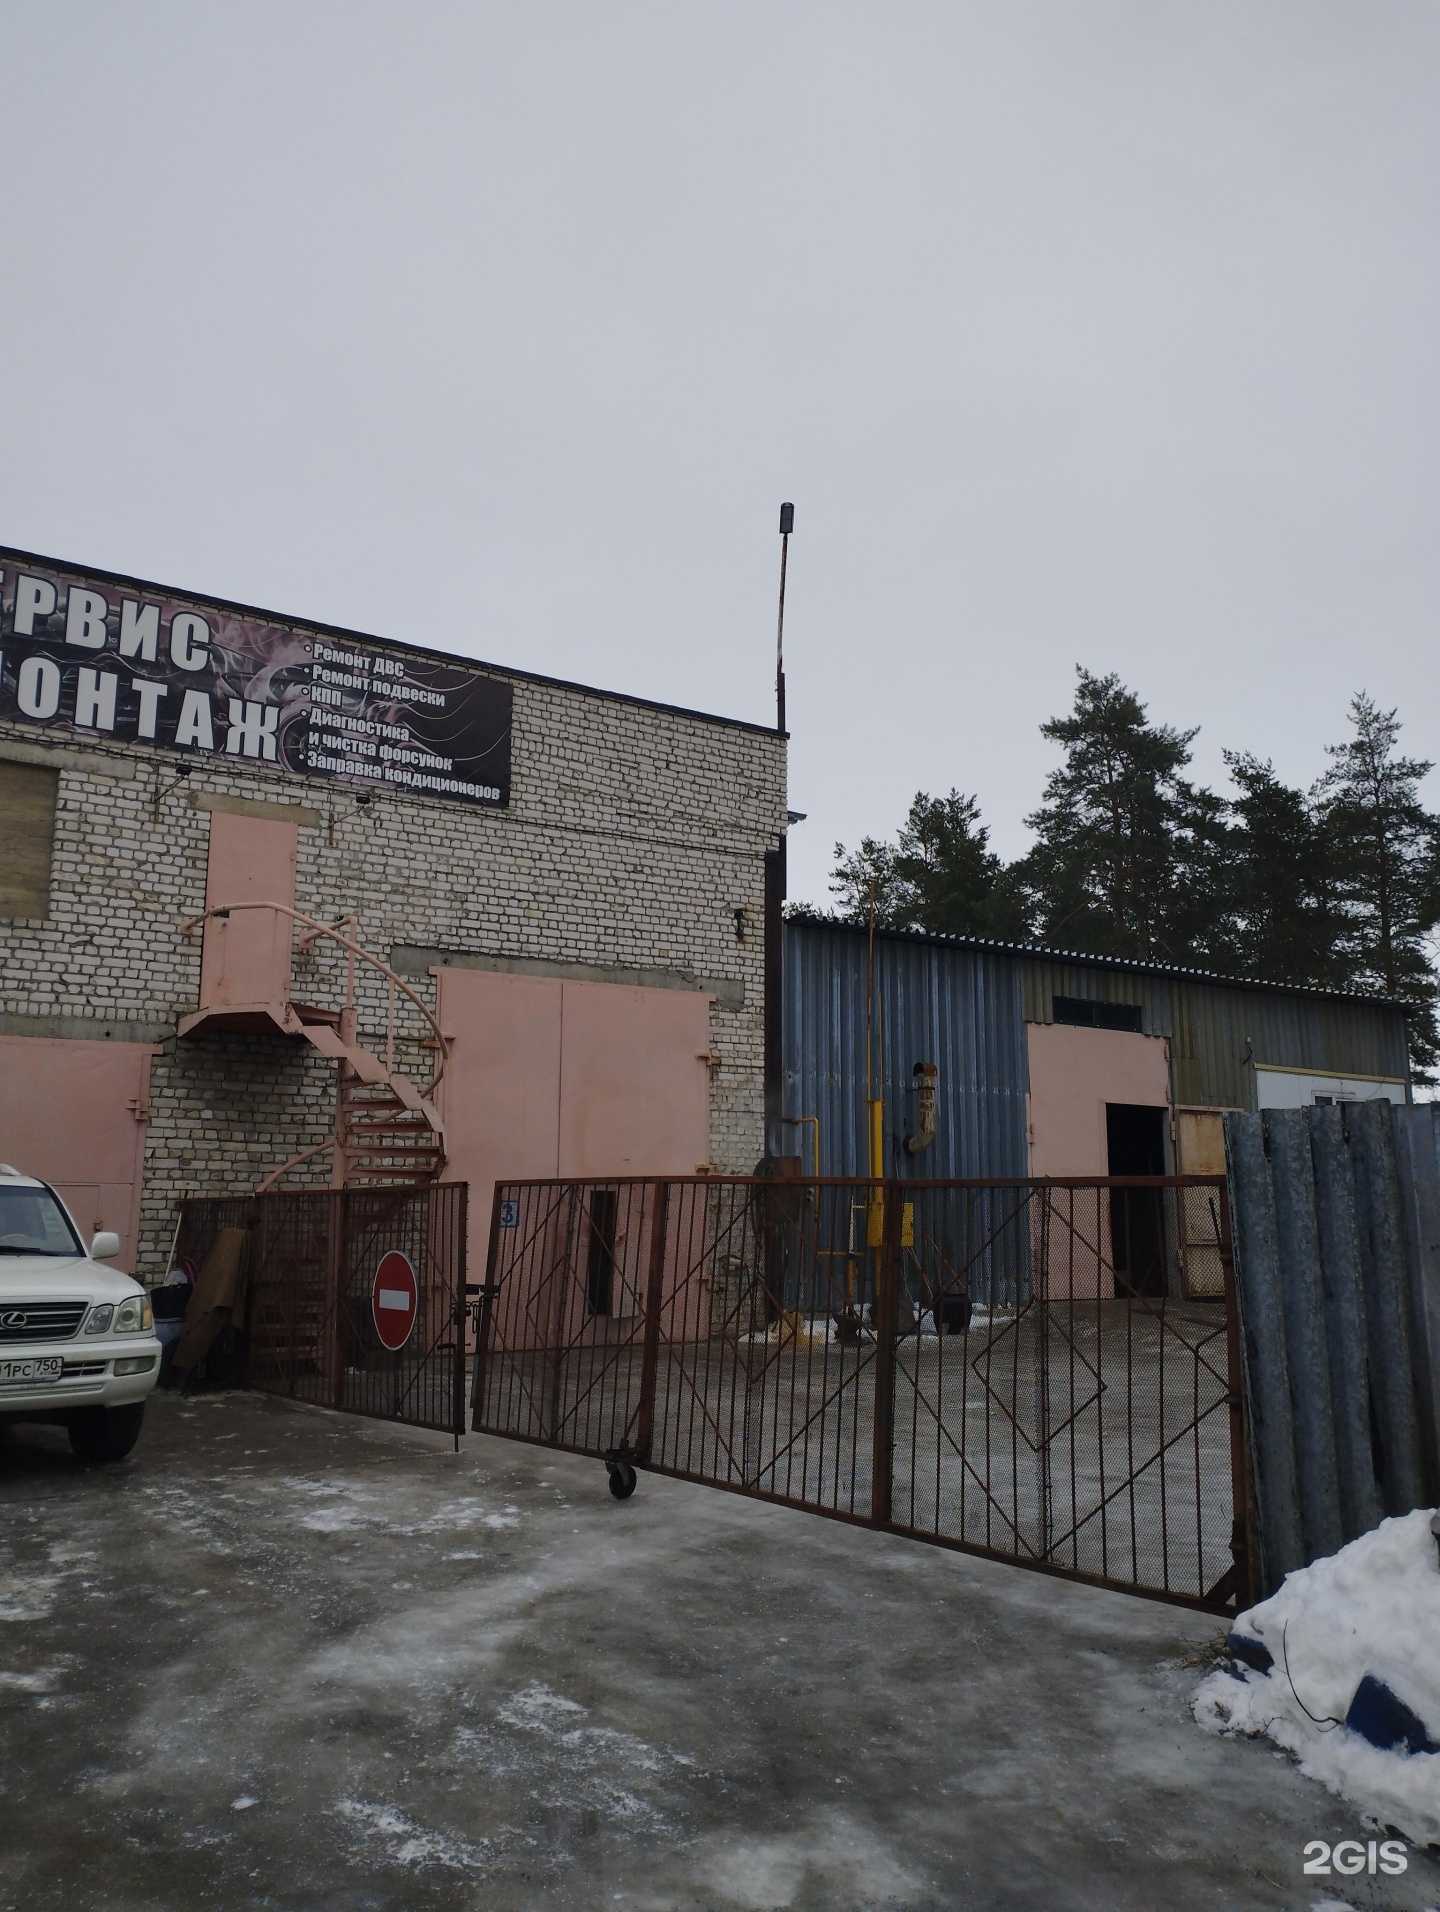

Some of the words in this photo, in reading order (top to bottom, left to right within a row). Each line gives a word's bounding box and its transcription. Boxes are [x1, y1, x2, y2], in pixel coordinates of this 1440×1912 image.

[0, 570, 210, 672] РВИС
[313, 643, 372, 670] Ремонт
[373, 657, 404, 677] ДВС
[311, 686, 342, 707] КПП
[312, 664, 370, 691] Ремонт
[372, 680, 446, 707] подвески
[0, 651, 280, 761] ОНТАЖ
[309, 708, 410, 742] Диагностика
[308, 732, 319, 745] и
[322, 734, 377, 757] чистка
[379, 744, 453, 771] форсунок
[307, 750, 382, 779] Заправка
[384, 767, 500, 801] кондиционеров
[0, 1363, 31, 1377] 1РС
